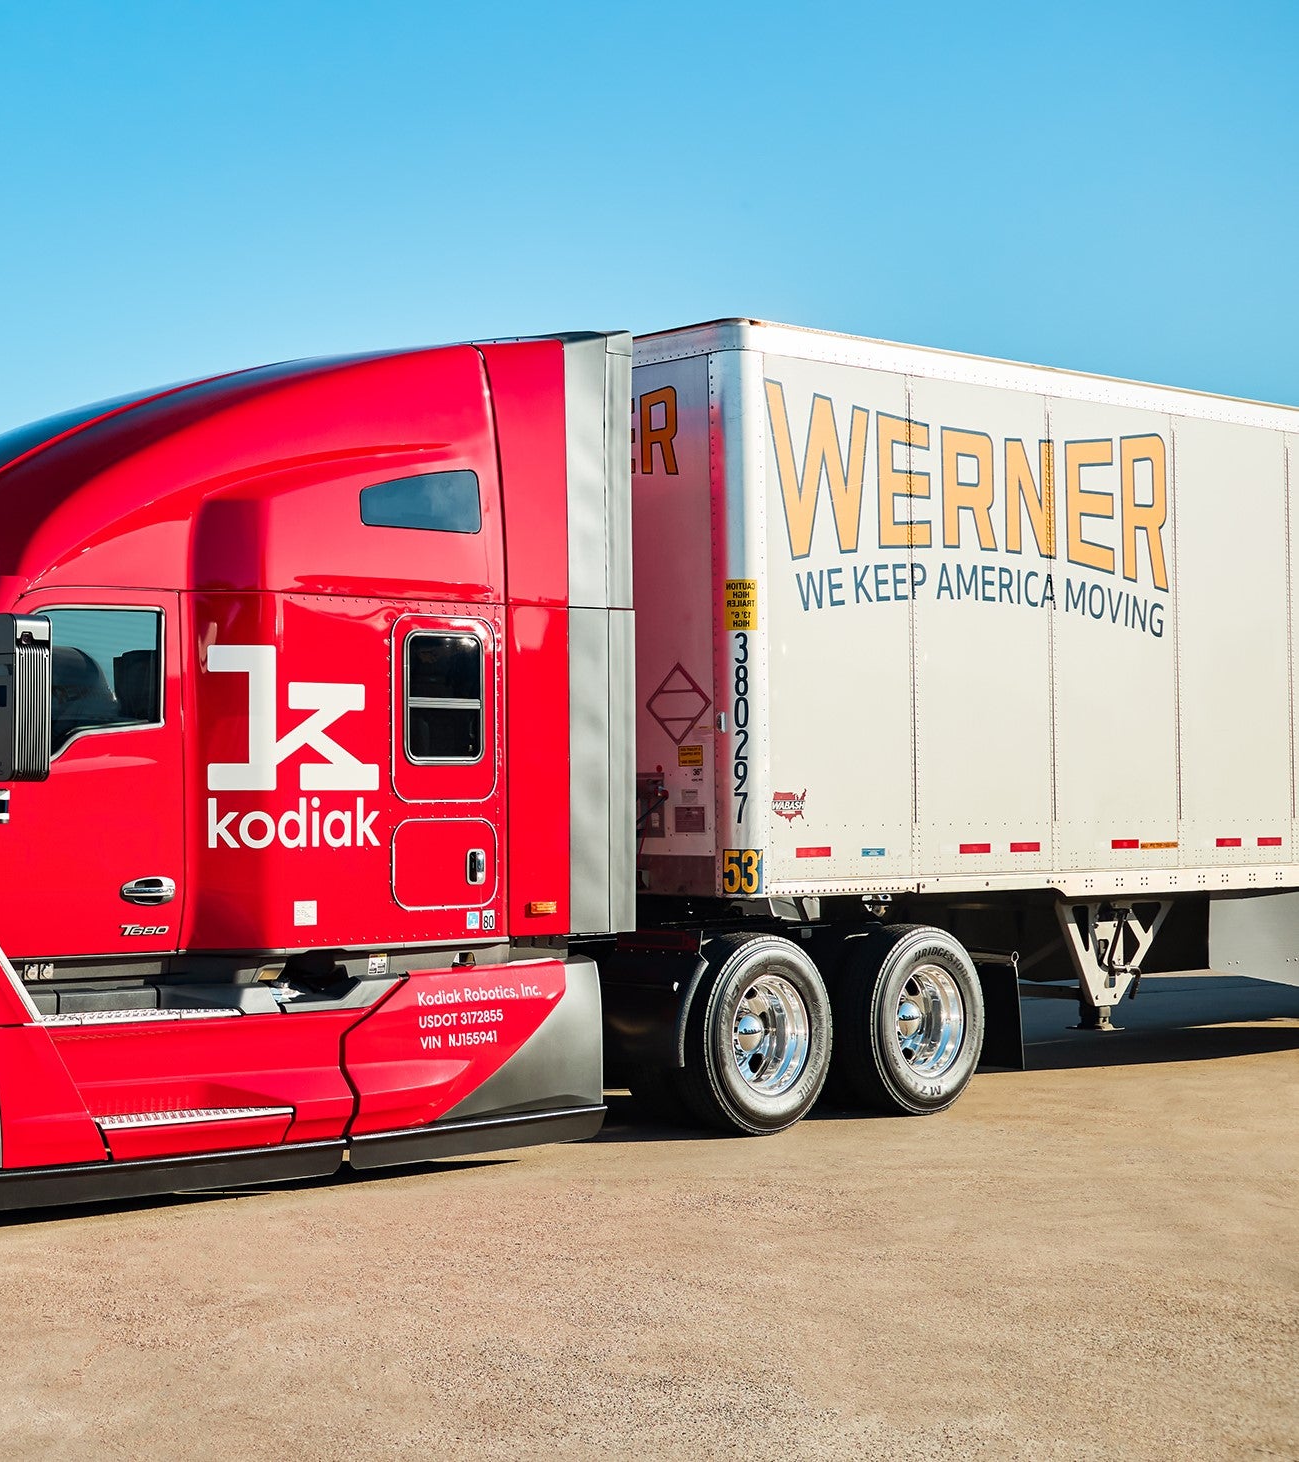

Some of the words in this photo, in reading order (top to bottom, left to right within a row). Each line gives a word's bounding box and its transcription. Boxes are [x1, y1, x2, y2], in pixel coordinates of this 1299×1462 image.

[631, 385, 679, 475] R
[764, 378, 1169, 593] WERNER
[795, 567, 846, 611] WE
[853, 562, 927, 603] KEEP
[936, 562, 1056, 610] AMERICA
[1065, 577, 1164, 638] MOVING
[734, 632, 749, 824] 380297
[771, 800, 805, 810] WABASH
[207, 796, 381, 849] kodiak
[119, 923, 170, 937] T680
[483, 914, 494, 929] 80
[417, 989, 461, 1006] Kodiak
[463, 984, 519, 1002] Robotics,
[521, 983, 542, 997] Inc.
[418, 1012, 458, 1029] USDOT
[460, 1009, 504, 1025] 3172855
[420, 1035, 442, 1050] VIN
[448, 1030, 498, 1047] NJ155941
